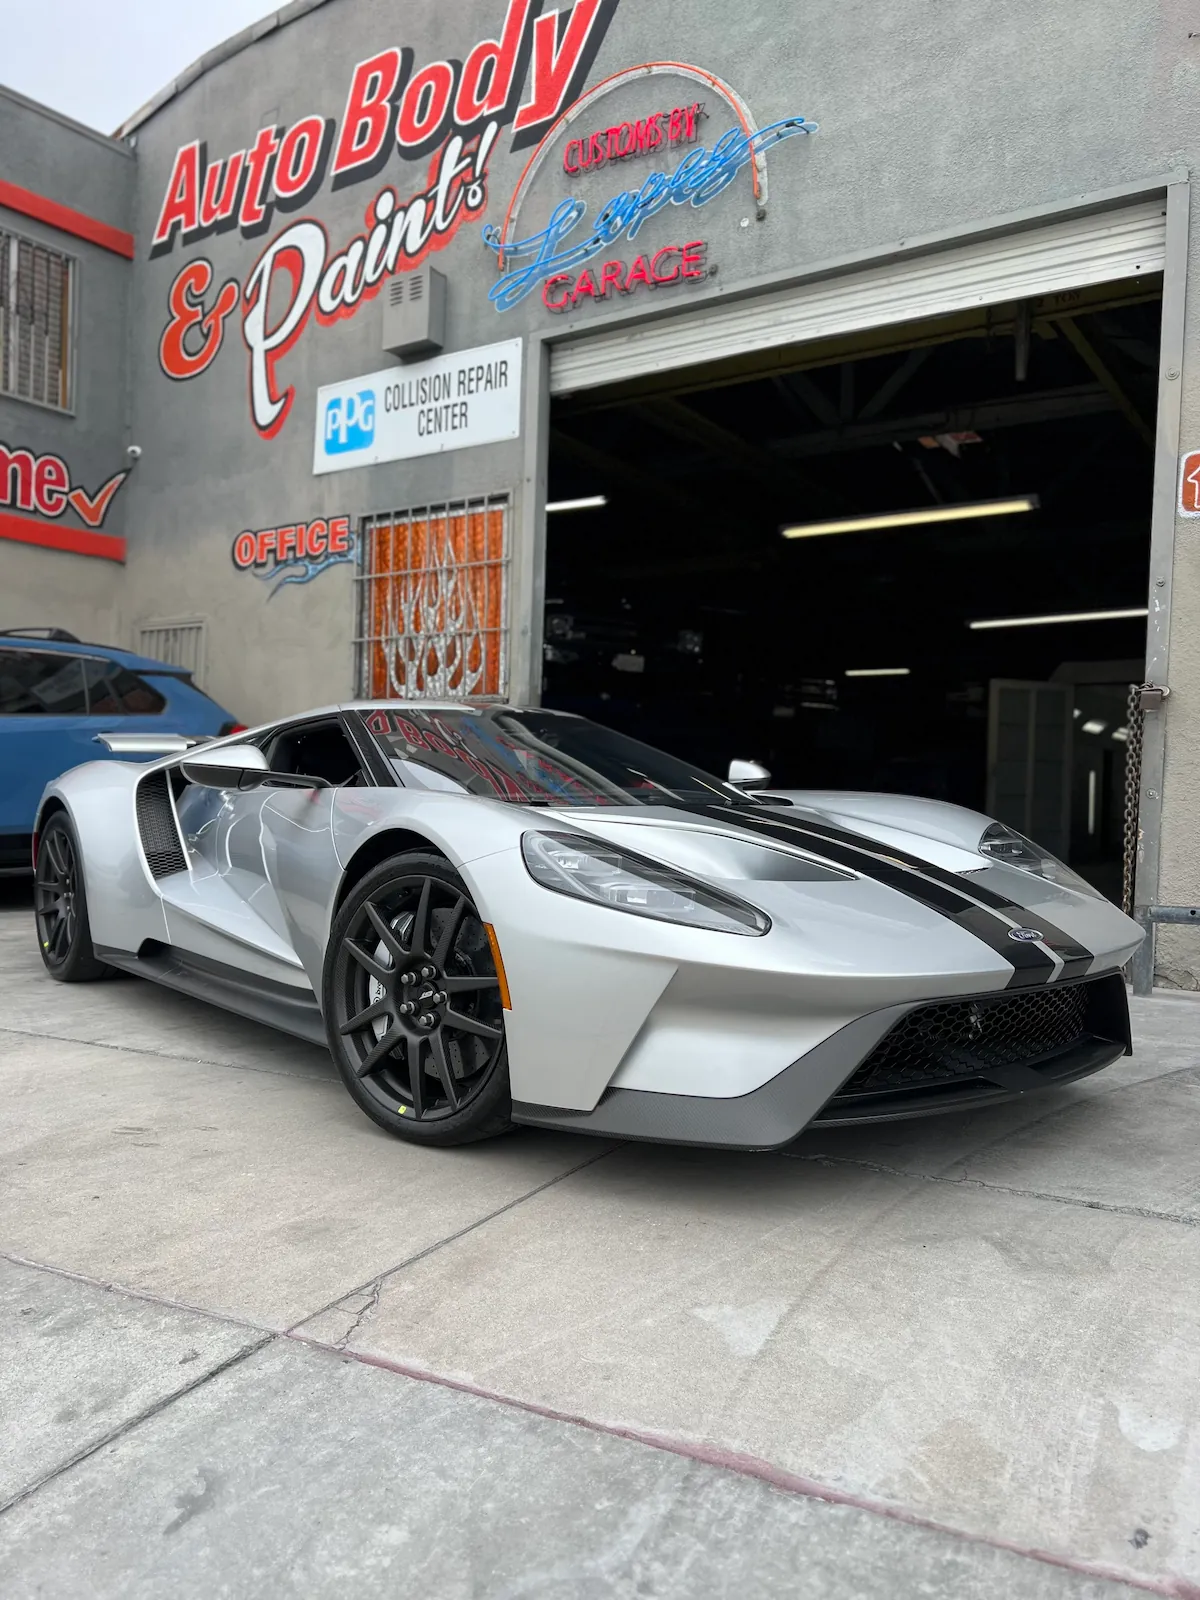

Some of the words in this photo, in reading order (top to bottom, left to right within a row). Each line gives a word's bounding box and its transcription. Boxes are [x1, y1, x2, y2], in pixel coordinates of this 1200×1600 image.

[151, 115, 326, 247] Auto
[331, 0, 602, 177] Body
[563, 111, 664, 174] CUSTOMS
[668, 102, 702, 141] BY
[160, 258, 239, 381] &
[242, 120, 498, 434] Paint!
[542, 241, 707, 311] GARAGE
[384, 371, 452, 413] COLLISION
[457, 360, 509, 398] REPAIR
[326, 391, 374, 445] PPG
[417, 401, 469, 437] CENTER
[232, 515, 351, 571] OFFICE
[1015, 930, 1037, 940] Ford
